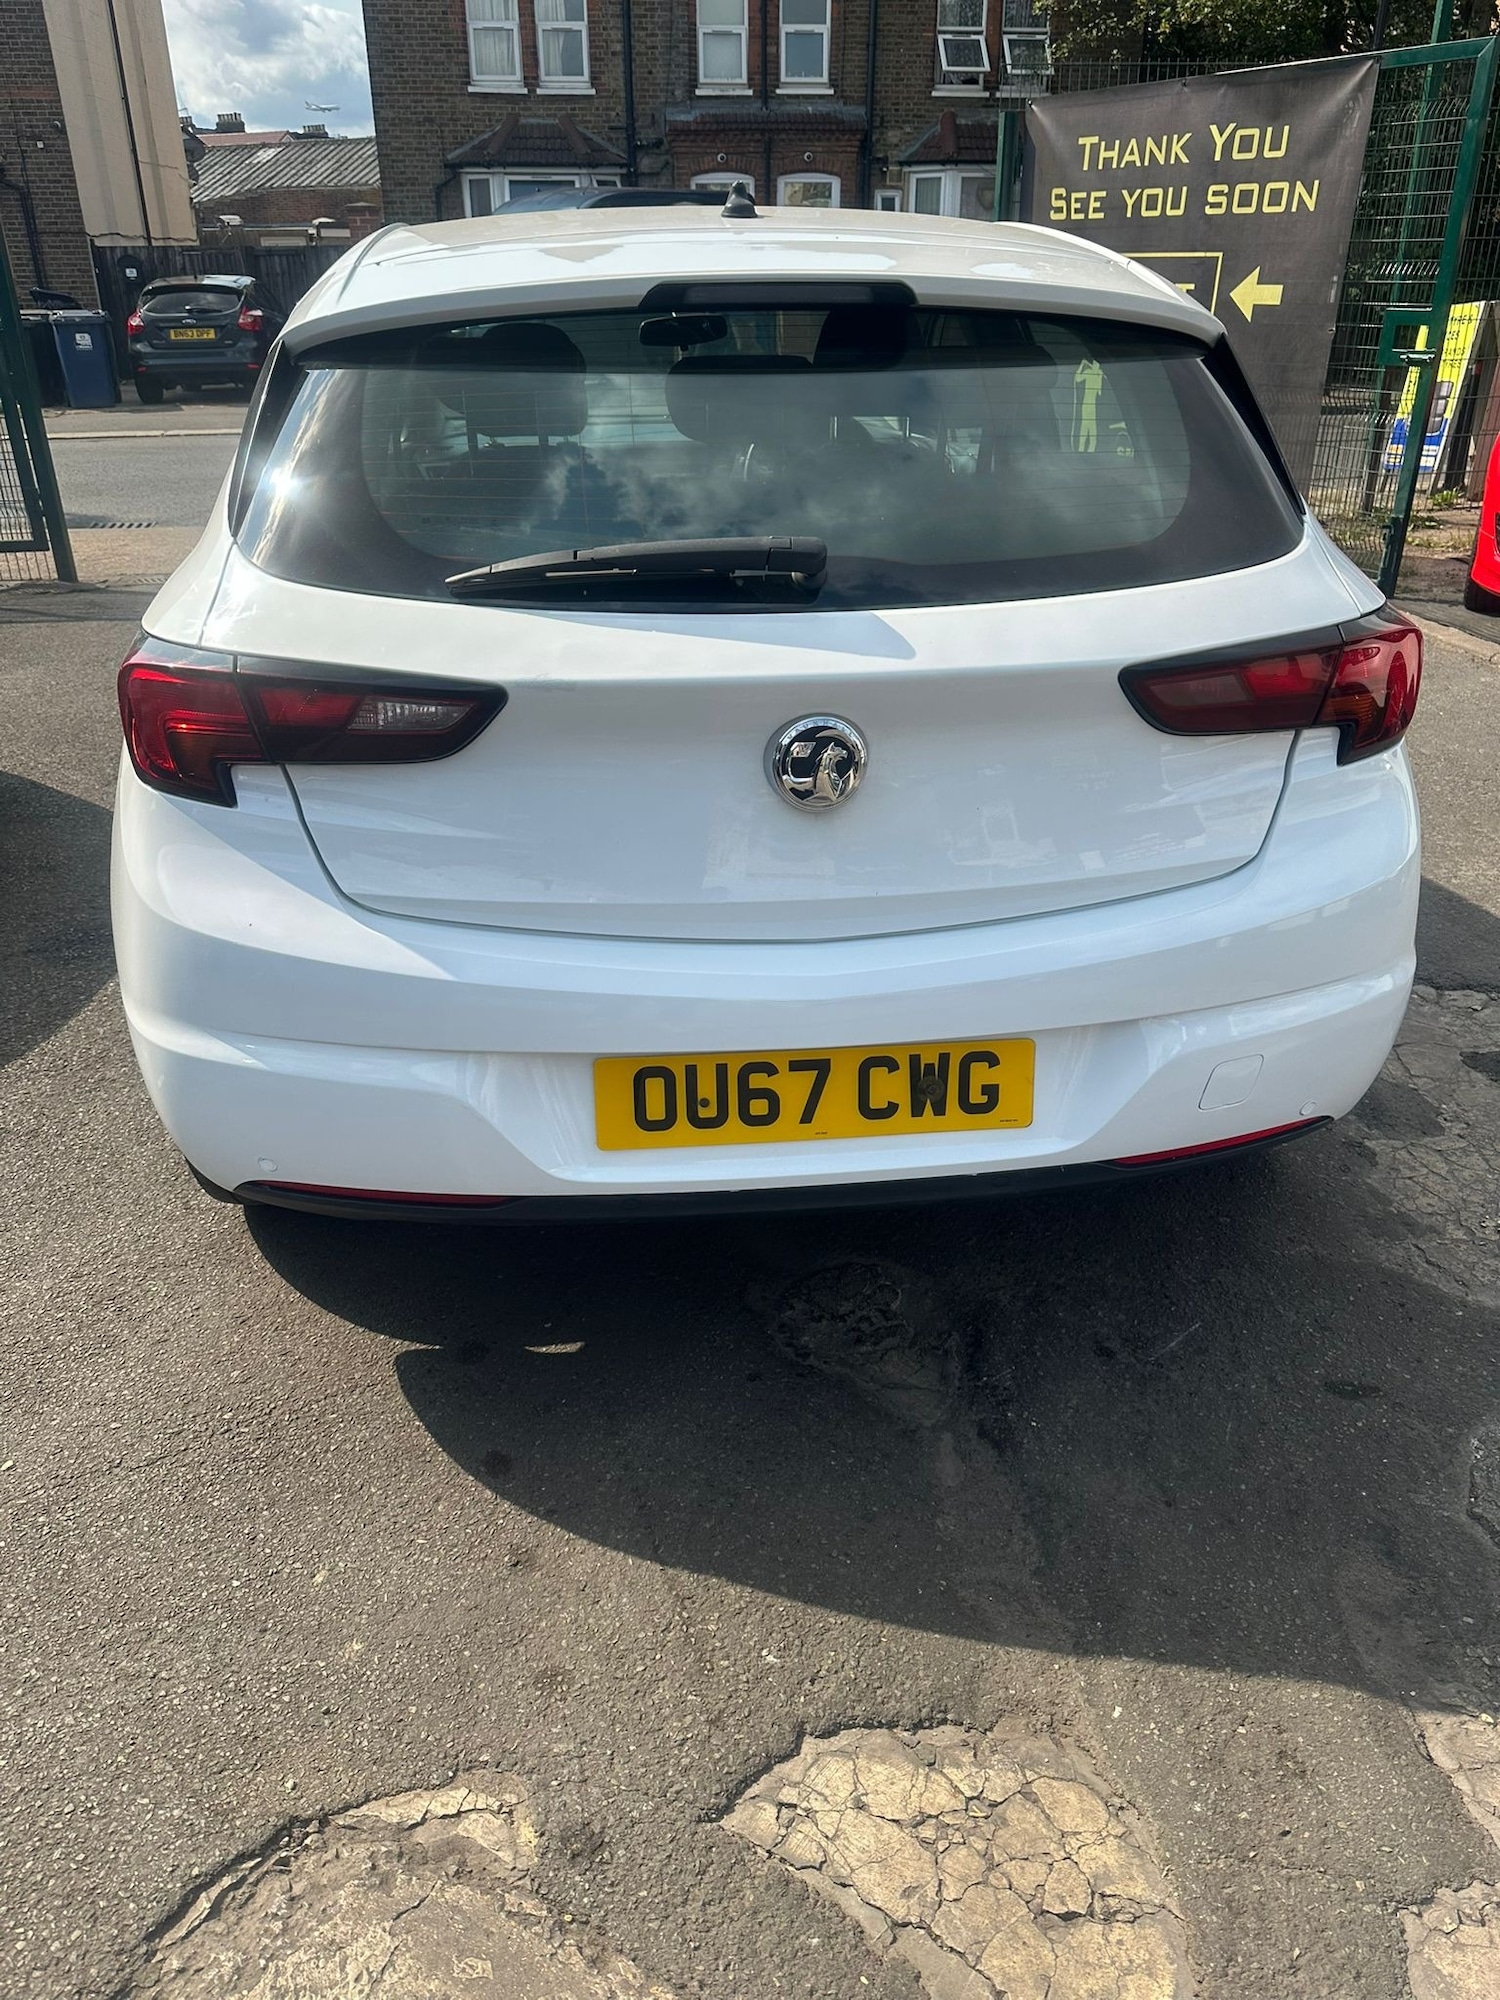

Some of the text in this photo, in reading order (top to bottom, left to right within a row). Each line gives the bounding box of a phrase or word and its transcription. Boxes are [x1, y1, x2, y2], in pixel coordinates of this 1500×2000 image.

[1078, 122, 1289, 171] THANK YOU
[1050, 179, 1320, 220] SEE YOU SOON
[173, 330, 195, 338] BN63
[633, 1050, 1001, 1132] OU67 CWG
